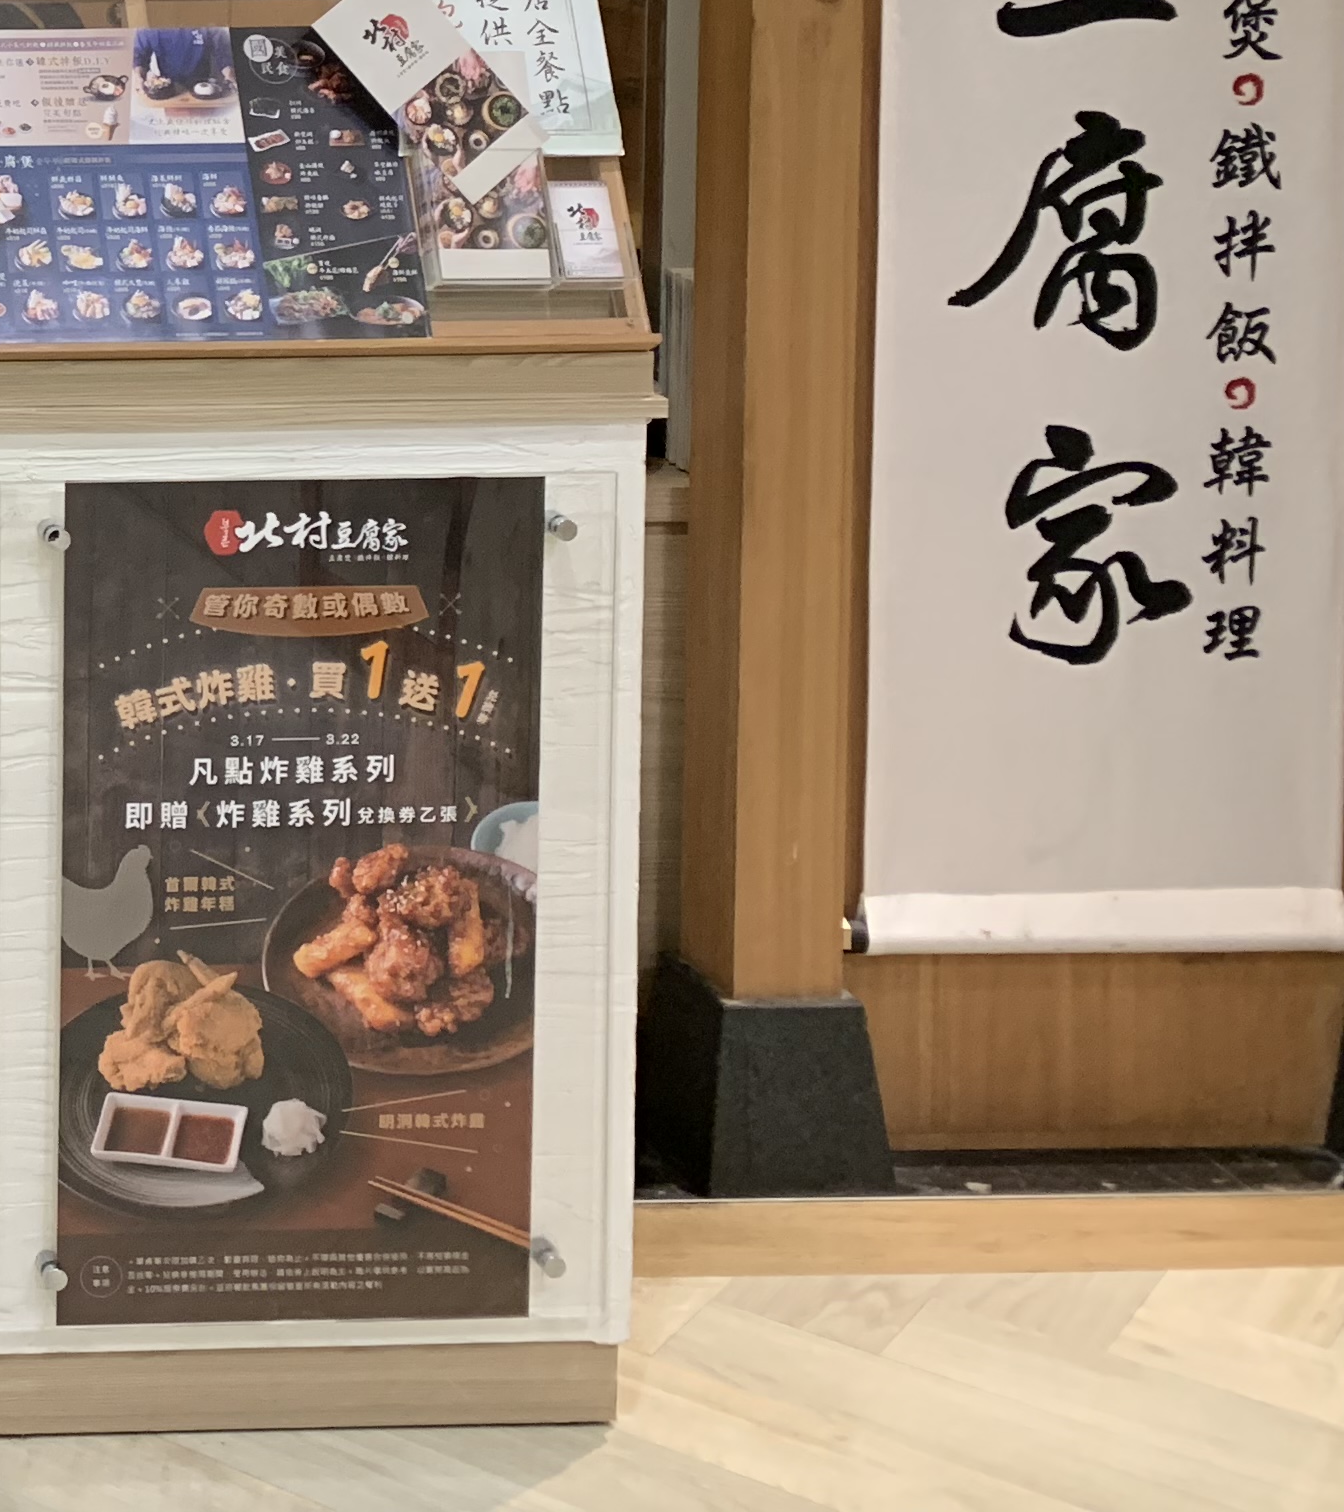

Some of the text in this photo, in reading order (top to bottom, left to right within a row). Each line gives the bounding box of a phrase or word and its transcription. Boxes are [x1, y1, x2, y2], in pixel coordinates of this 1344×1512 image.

[235, 511, 408, 552] 北村豆腐家
[203, 592, 411, 620] 管你奇數或偶數
[230, 733, 360, 747] 3.17 3.22
[189, 753, 396, 785] 凡點炸雞系列
